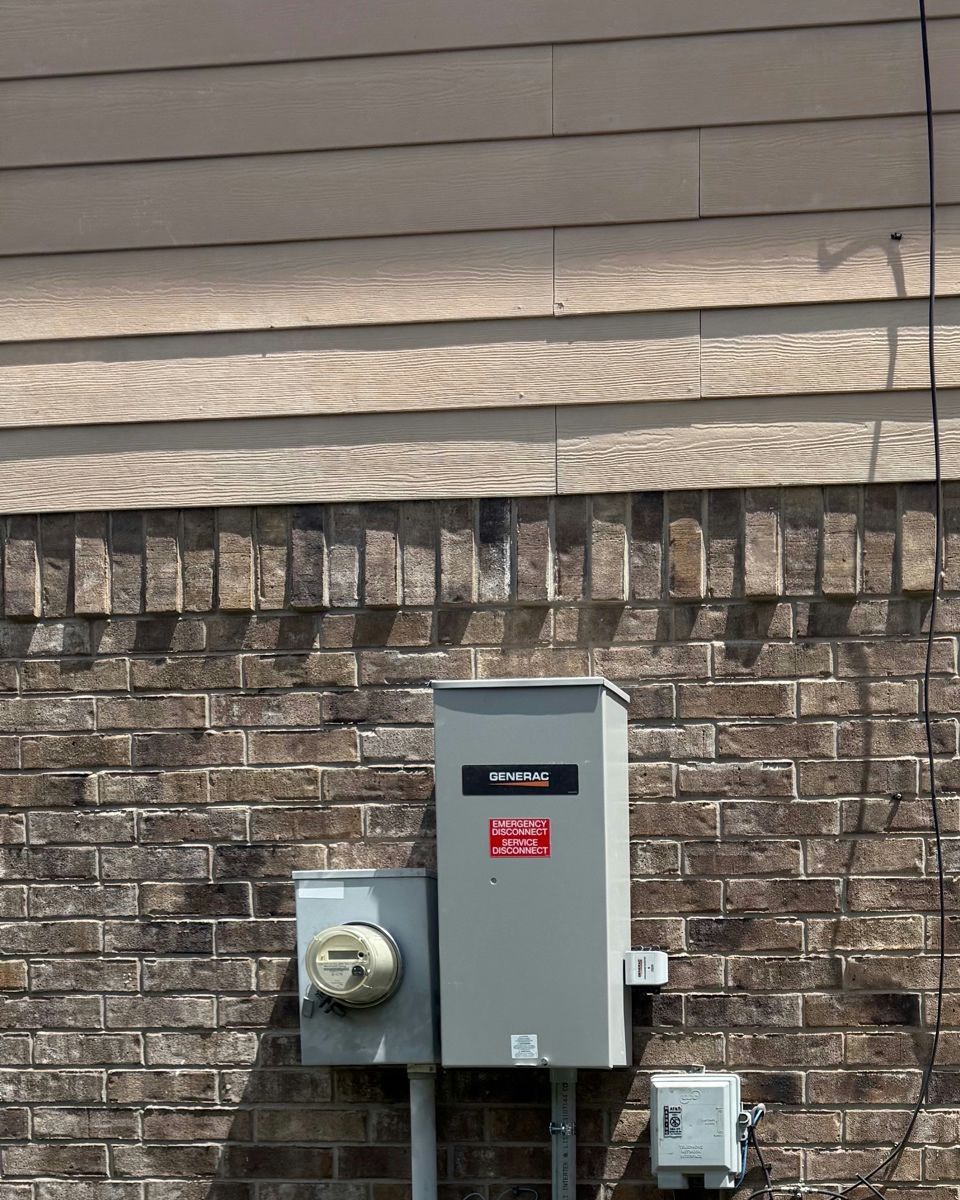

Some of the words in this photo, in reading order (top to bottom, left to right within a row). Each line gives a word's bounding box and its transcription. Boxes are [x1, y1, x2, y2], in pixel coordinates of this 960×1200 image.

[489, 772, 550, 781] GENERAC
[492, 820, 547, 828] EMERGENCY
[491, 828, 548, 836] DISCONNECT
[502, 838, 538, 847] SERVICE
[492, 847, 548, 855] DISCONNECT
